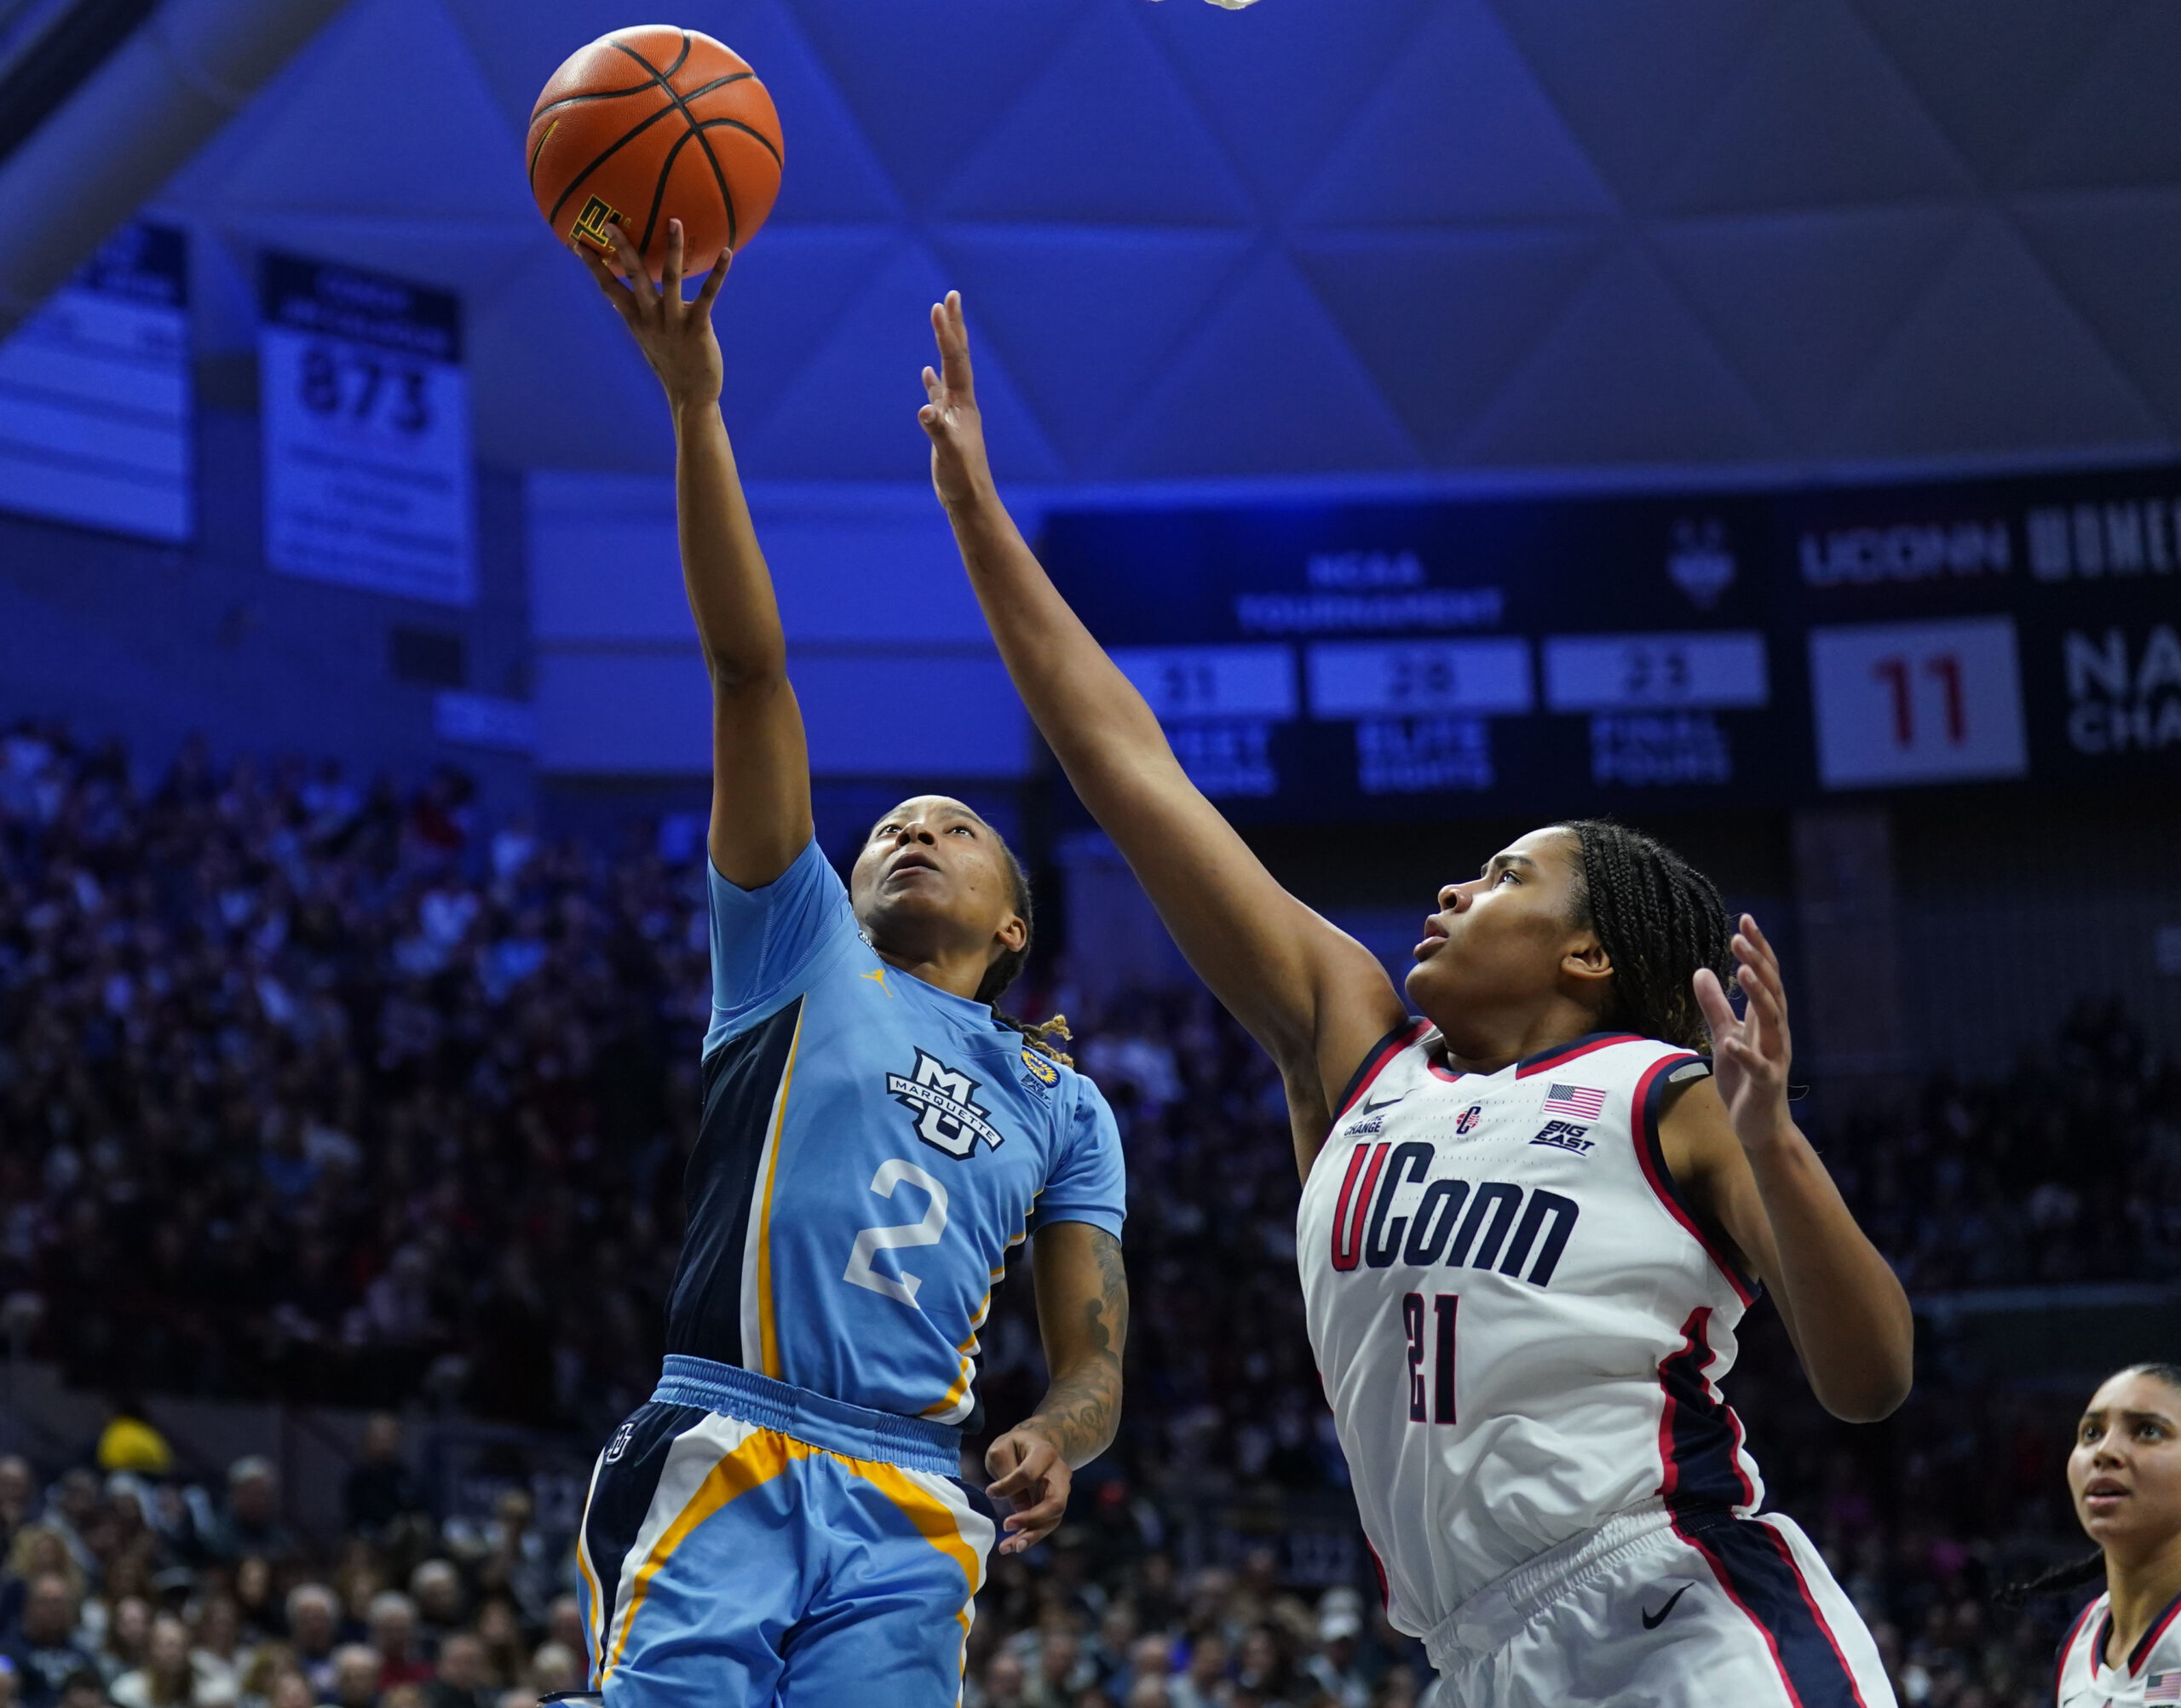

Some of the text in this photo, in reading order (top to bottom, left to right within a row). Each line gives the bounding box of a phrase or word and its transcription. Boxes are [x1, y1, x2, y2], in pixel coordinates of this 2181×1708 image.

[1870, 652, 1966, 750] 11
[895, 1080, 996, 1142] MARQUETTE
[1344, 1120, 1384, 1136] CHANGE
[1534, 1130, 1596, 1151] EAST
[1544, 1119, 1589, 1138] BIG
[843, 1159, 949, 1310] 2
[1331, 1142, 1580, 1287] UConn
[1402, 1292, 1459, 1425] 21
